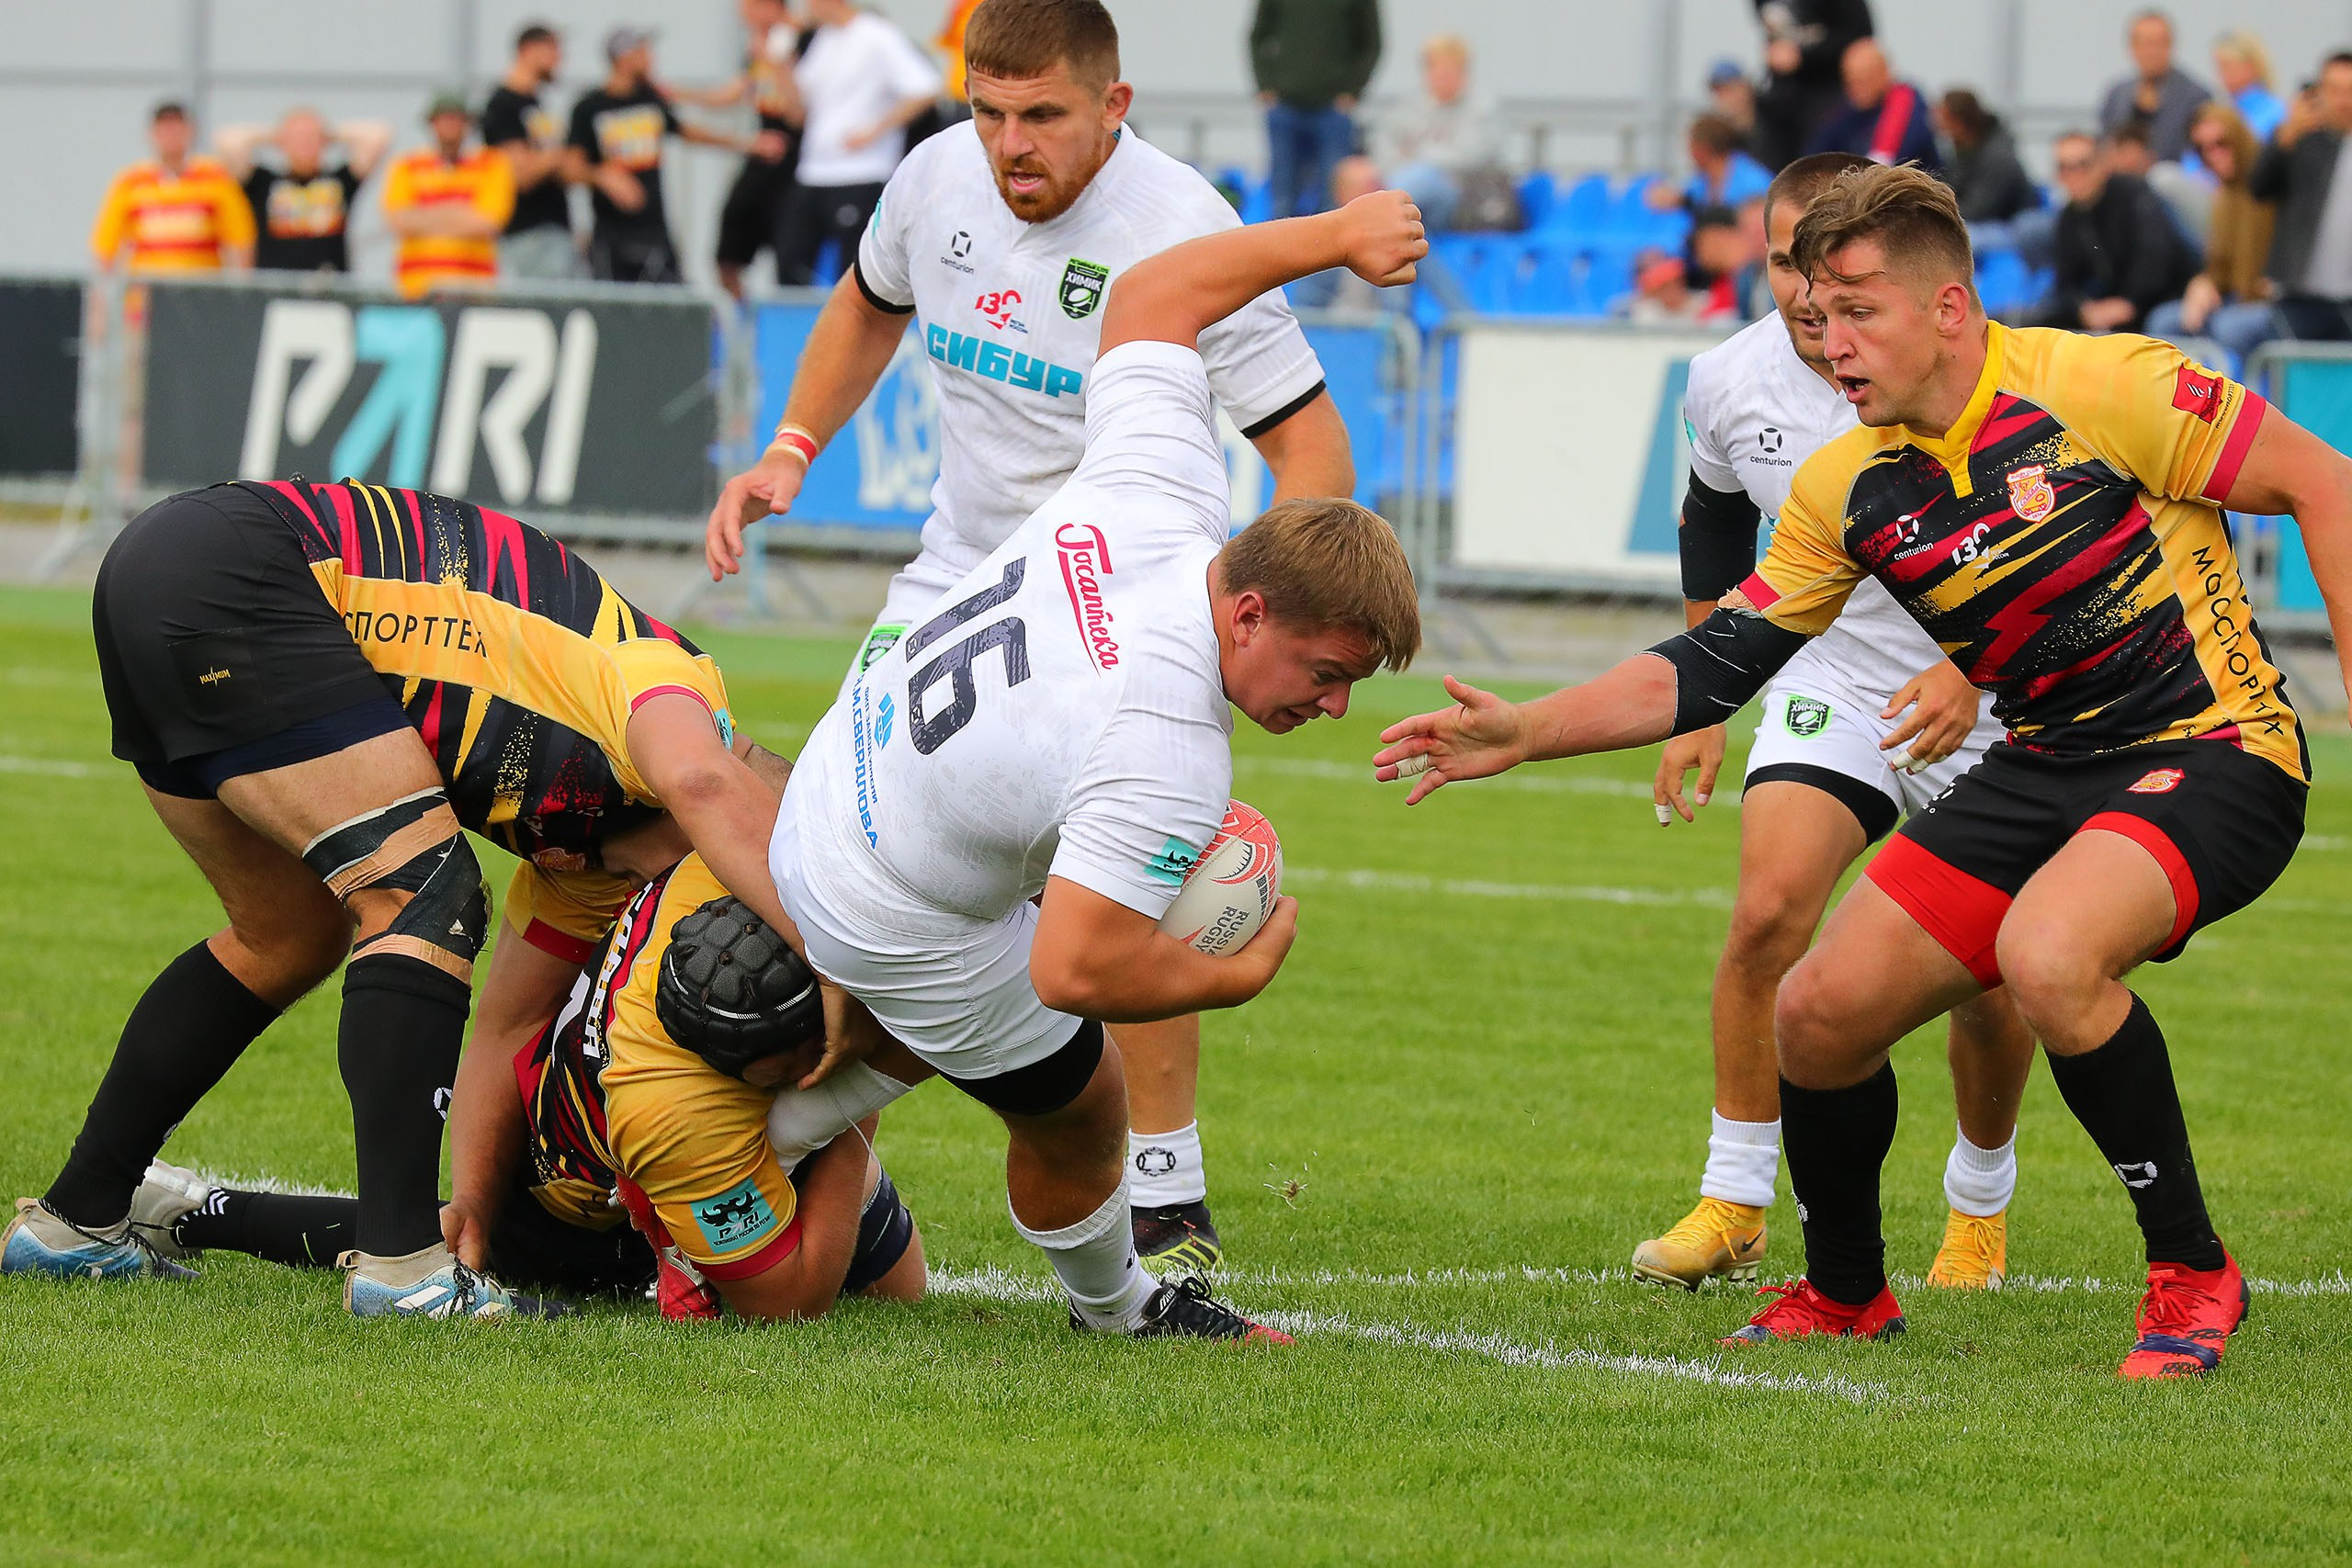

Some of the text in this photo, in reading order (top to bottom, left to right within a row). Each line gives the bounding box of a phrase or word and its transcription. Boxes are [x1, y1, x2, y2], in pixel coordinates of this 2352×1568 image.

[940, 256, 975, 275] centurion
[1065, 271, 1102, 292] ХИМИК
[927, 322, 1082, 398] СИБУР
[237, 300, 598, 505] PARI
[1749, 456, 1792, 467] centurion
[1894, 542, 1933, 560] centurion
[1056, 524, 1120, 673] Госаптека
[2192, 546, 2284, 736] МОССПОРТТХ
[906, 556, 1030, 755] 16
[198, 667, 231, 686] MAXIMUM
[1791, 704, 1827, 713] ХИМИК
[1195, 906, 1238, 952] RUGBY
[718, 1211, 760, 1239] PARI
